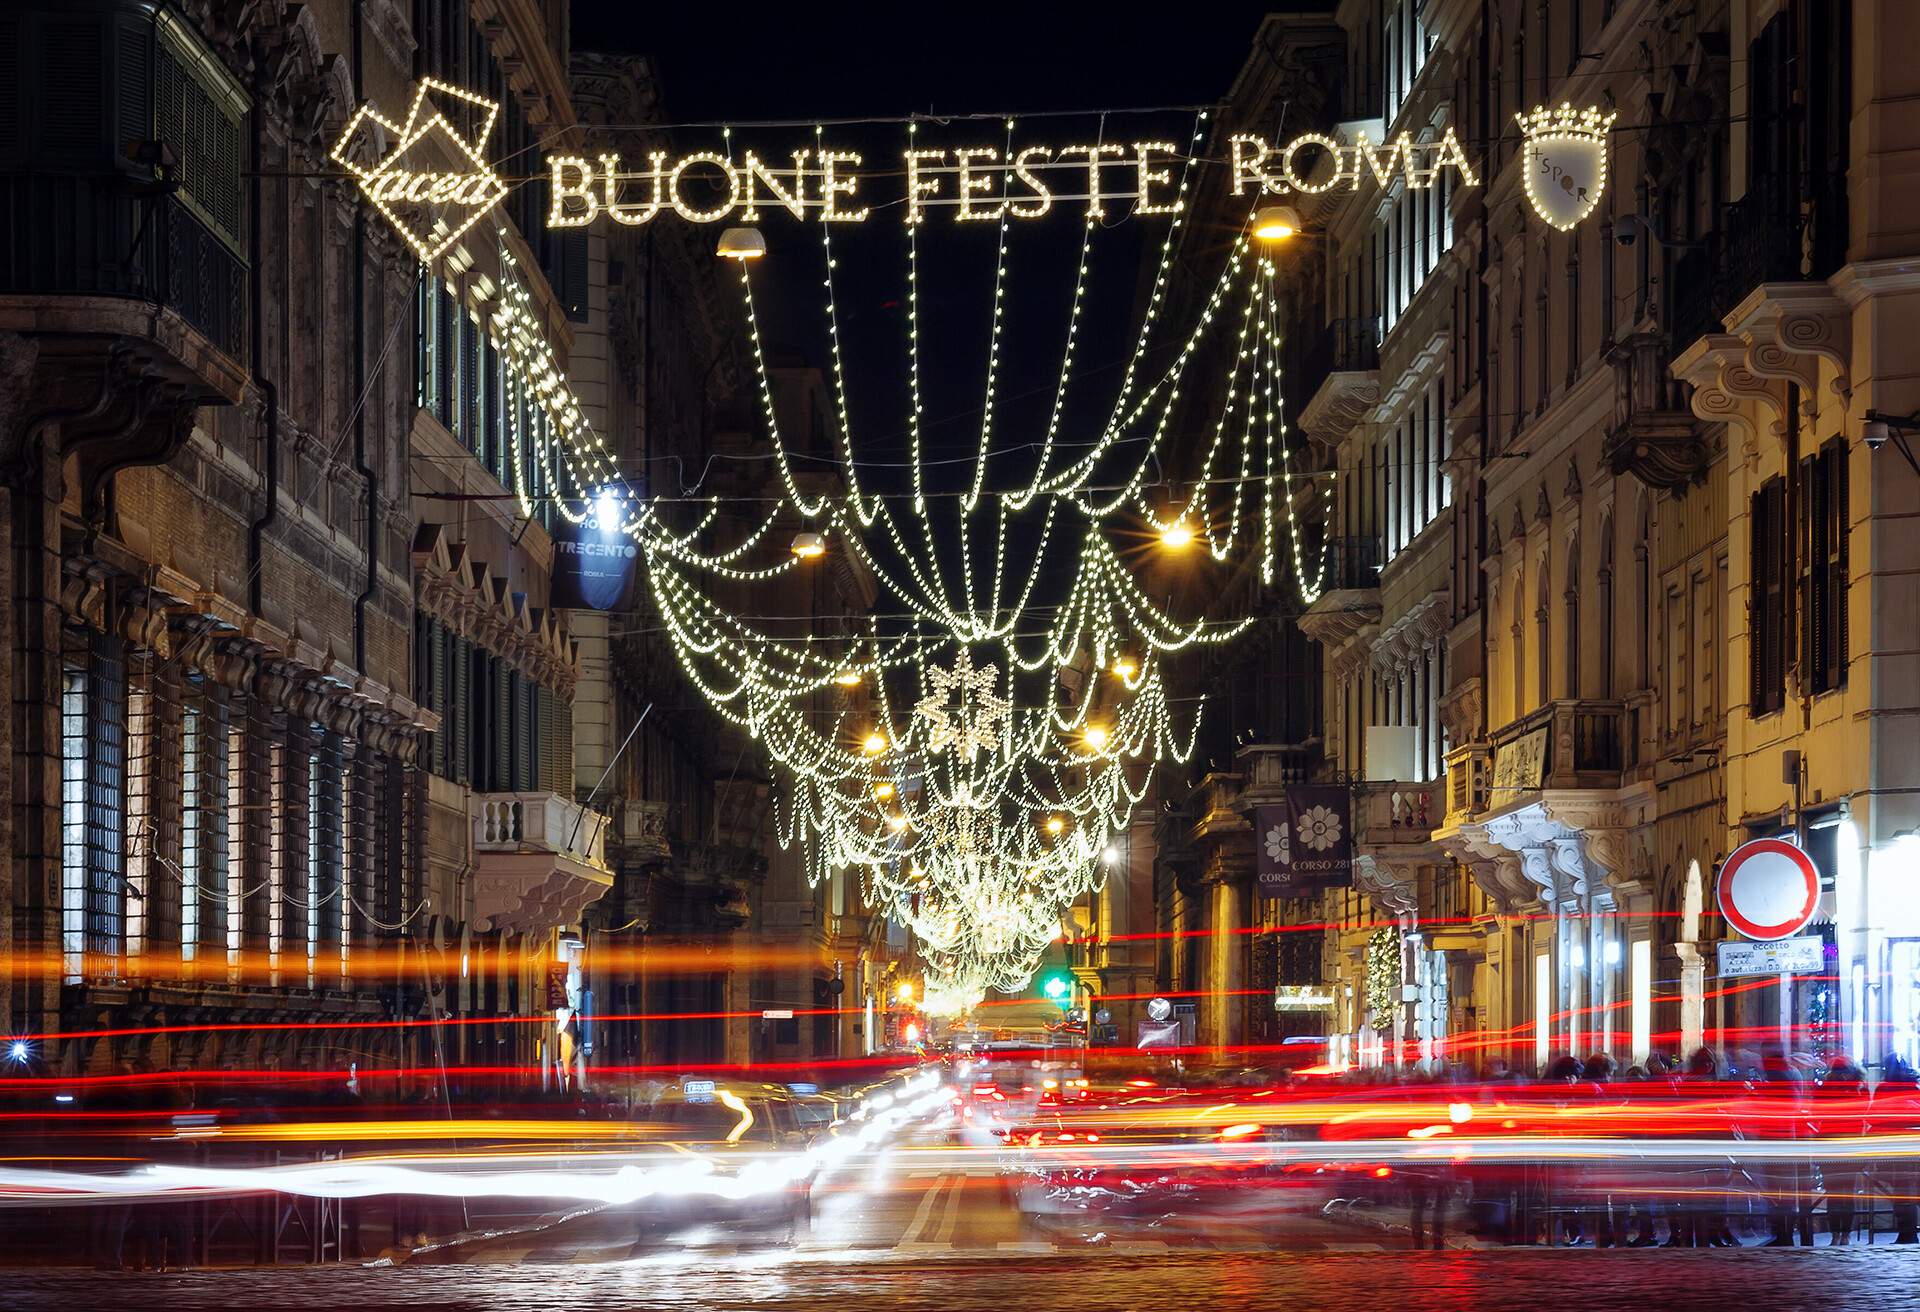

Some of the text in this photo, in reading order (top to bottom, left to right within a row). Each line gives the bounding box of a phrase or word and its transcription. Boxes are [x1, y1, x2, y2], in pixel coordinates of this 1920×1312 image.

[371, 170, 497, 205] acea
[547, 126, 1481, 228] BUONE FESTE ROMA
[1292, 860, 1331, 871] CORSO
[1752, 942, 1790, 950] eccetto
